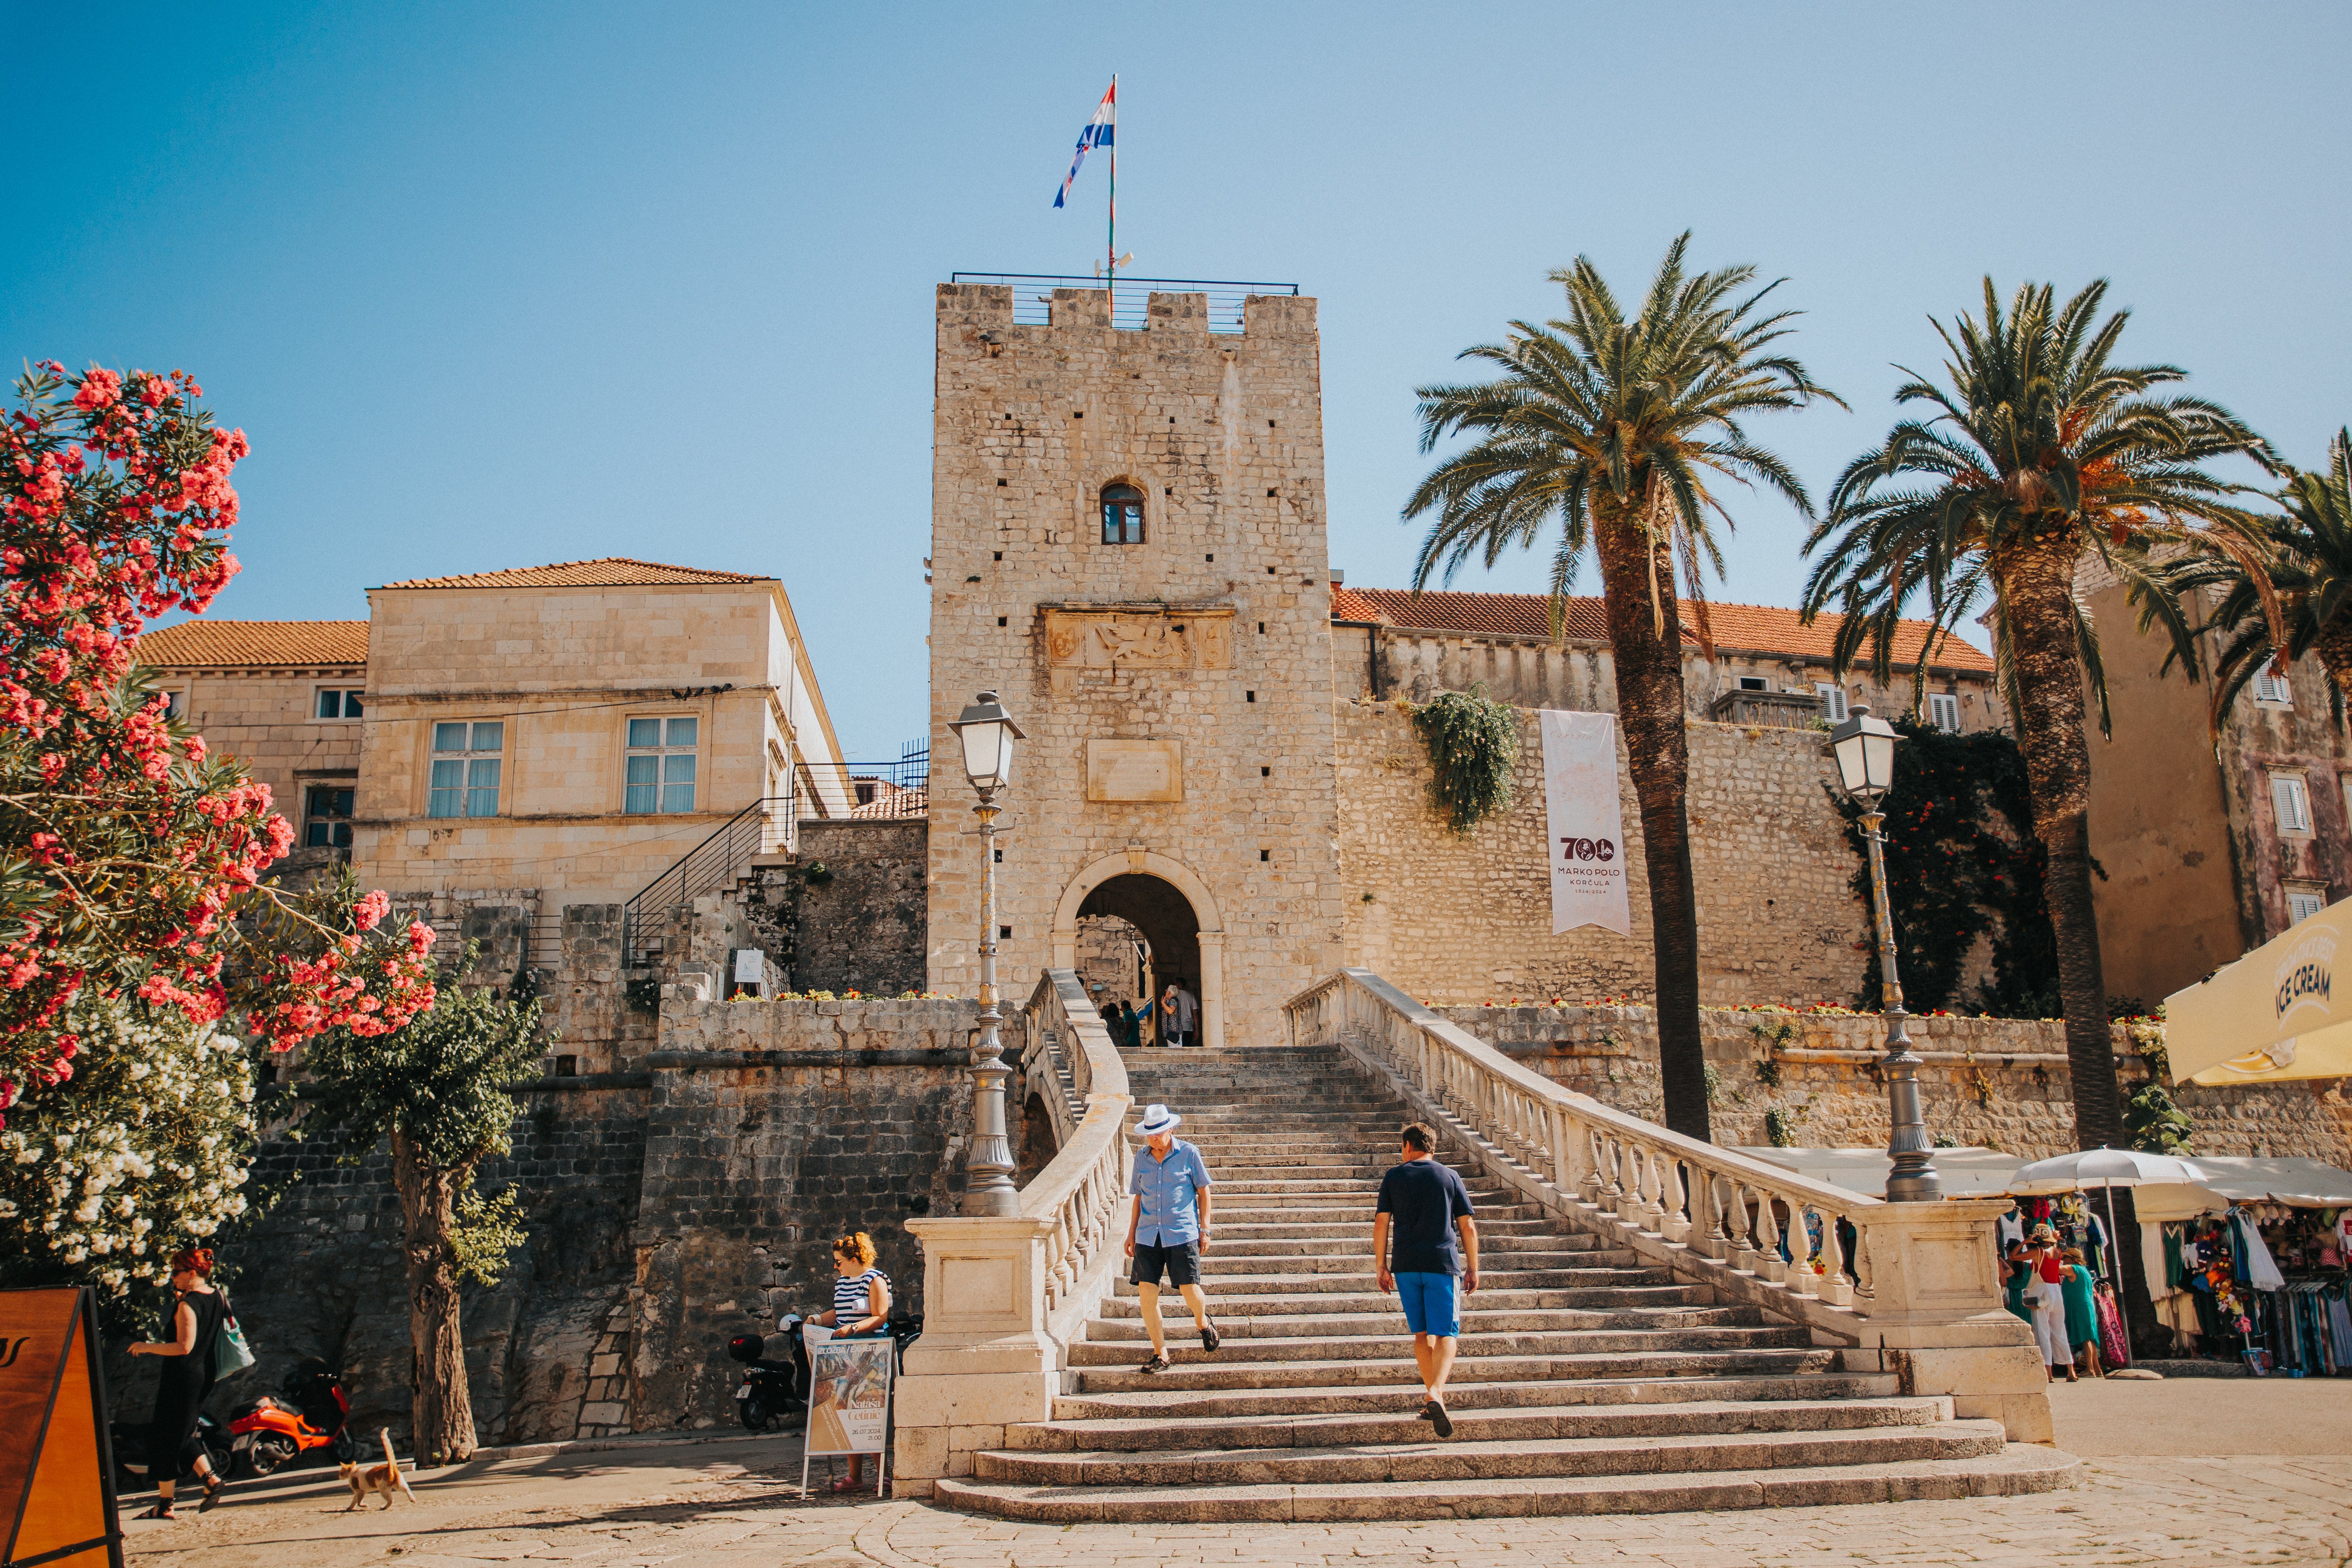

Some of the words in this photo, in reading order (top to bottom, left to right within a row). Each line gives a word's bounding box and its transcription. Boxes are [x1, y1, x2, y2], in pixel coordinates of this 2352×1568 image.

[1560, 837, 1614, 862] 700
[1558, 867, 1593, 876] MARKO
[2276, 976, 2291, 1020] ICE
[2294, 964, 2331, 1002] CREAM
[818, 1345, 846, 1354] IZLOŽBA
[851, 1344, 889, 1353] EXHIBITION
[851, 1398, 881, 1409] Nataša
[848, 1409, 881, 1420] Cetinić
